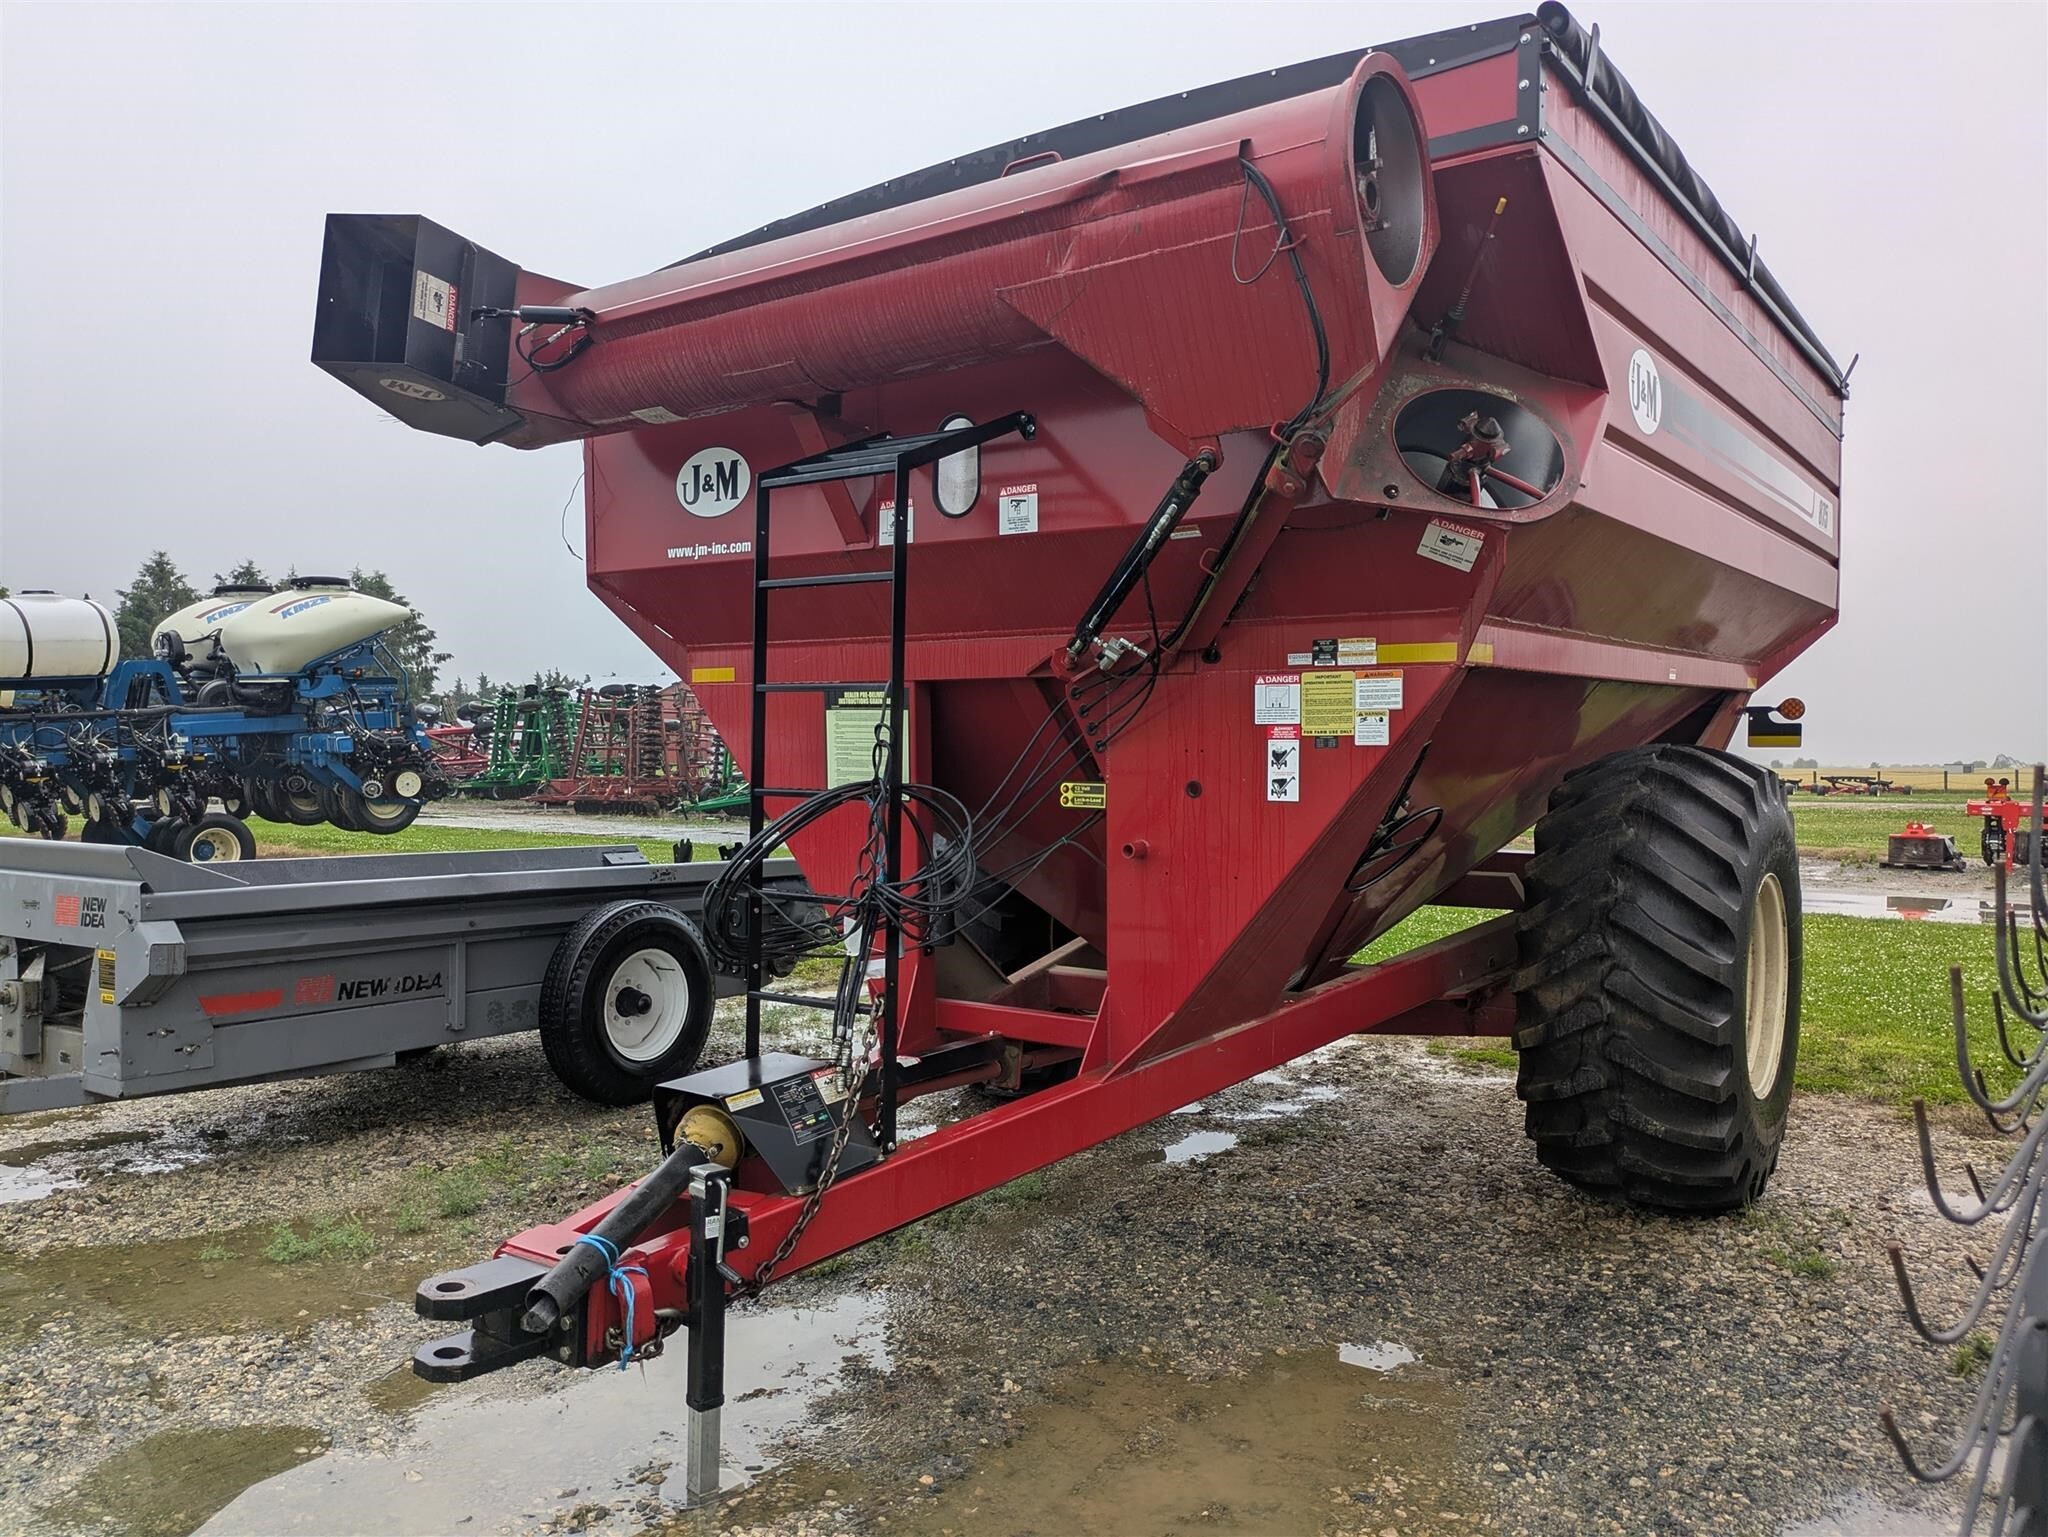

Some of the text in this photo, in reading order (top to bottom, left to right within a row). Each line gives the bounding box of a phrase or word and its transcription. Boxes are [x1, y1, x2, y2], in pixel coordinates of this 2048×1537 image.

[447, 294, 456, 331] DANGER
[1631, 359, 1657, 423] J&M
[681, 459, 741, 505] J&M
[1007, 484, 1038, 495] DANGER
[1441, 520, 1486, 540] DANGER
[667, 541, 752, 560] www.jm-inc.com
[281, 596, 331, 620] KINZE
[1265, 675, 1300, 683] DANGER
[82, 896, 107, 913] NEW
[80, 912, 105, 929] IDEA
[337, 977, 391, 1001] NEW
